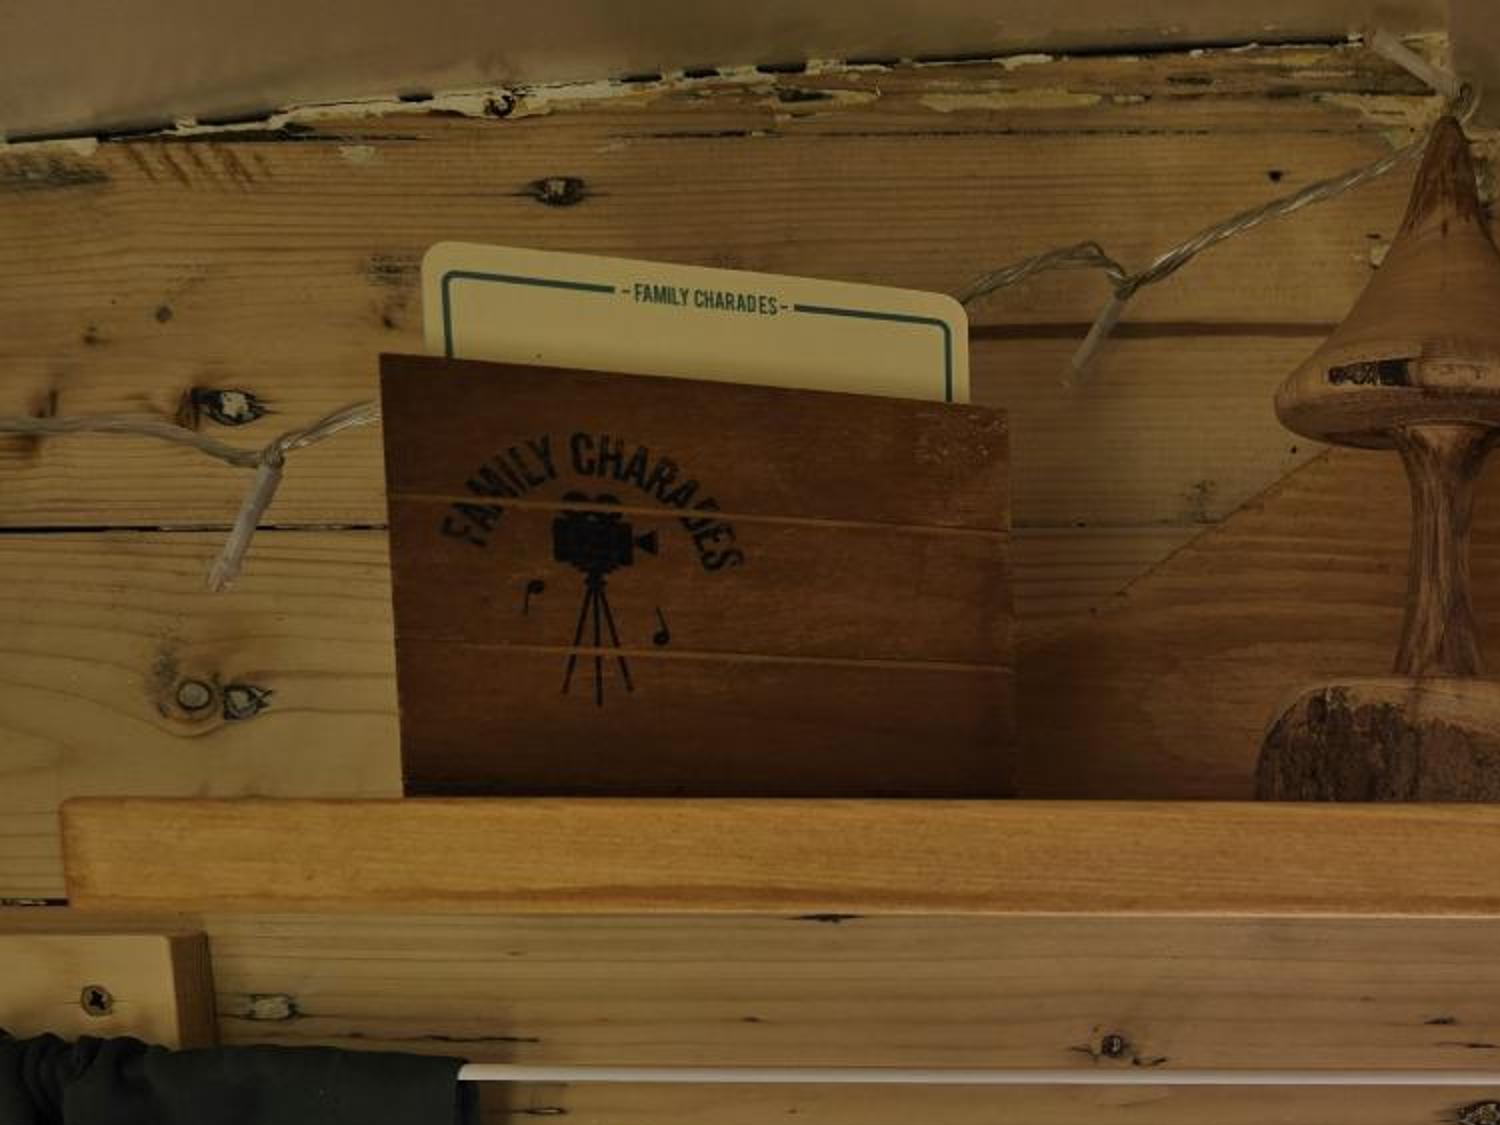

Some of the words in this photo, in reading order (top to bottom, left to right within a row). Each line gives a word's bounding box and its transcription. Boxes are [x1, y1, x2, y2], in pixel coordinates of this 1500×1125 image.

[634, 283, 689, 307] FAMILY
[693, 288, 778, 316] CHARADES
[439, 432, 558, 548] FAMILY
[570, 431, 746, 573] CHARADES
